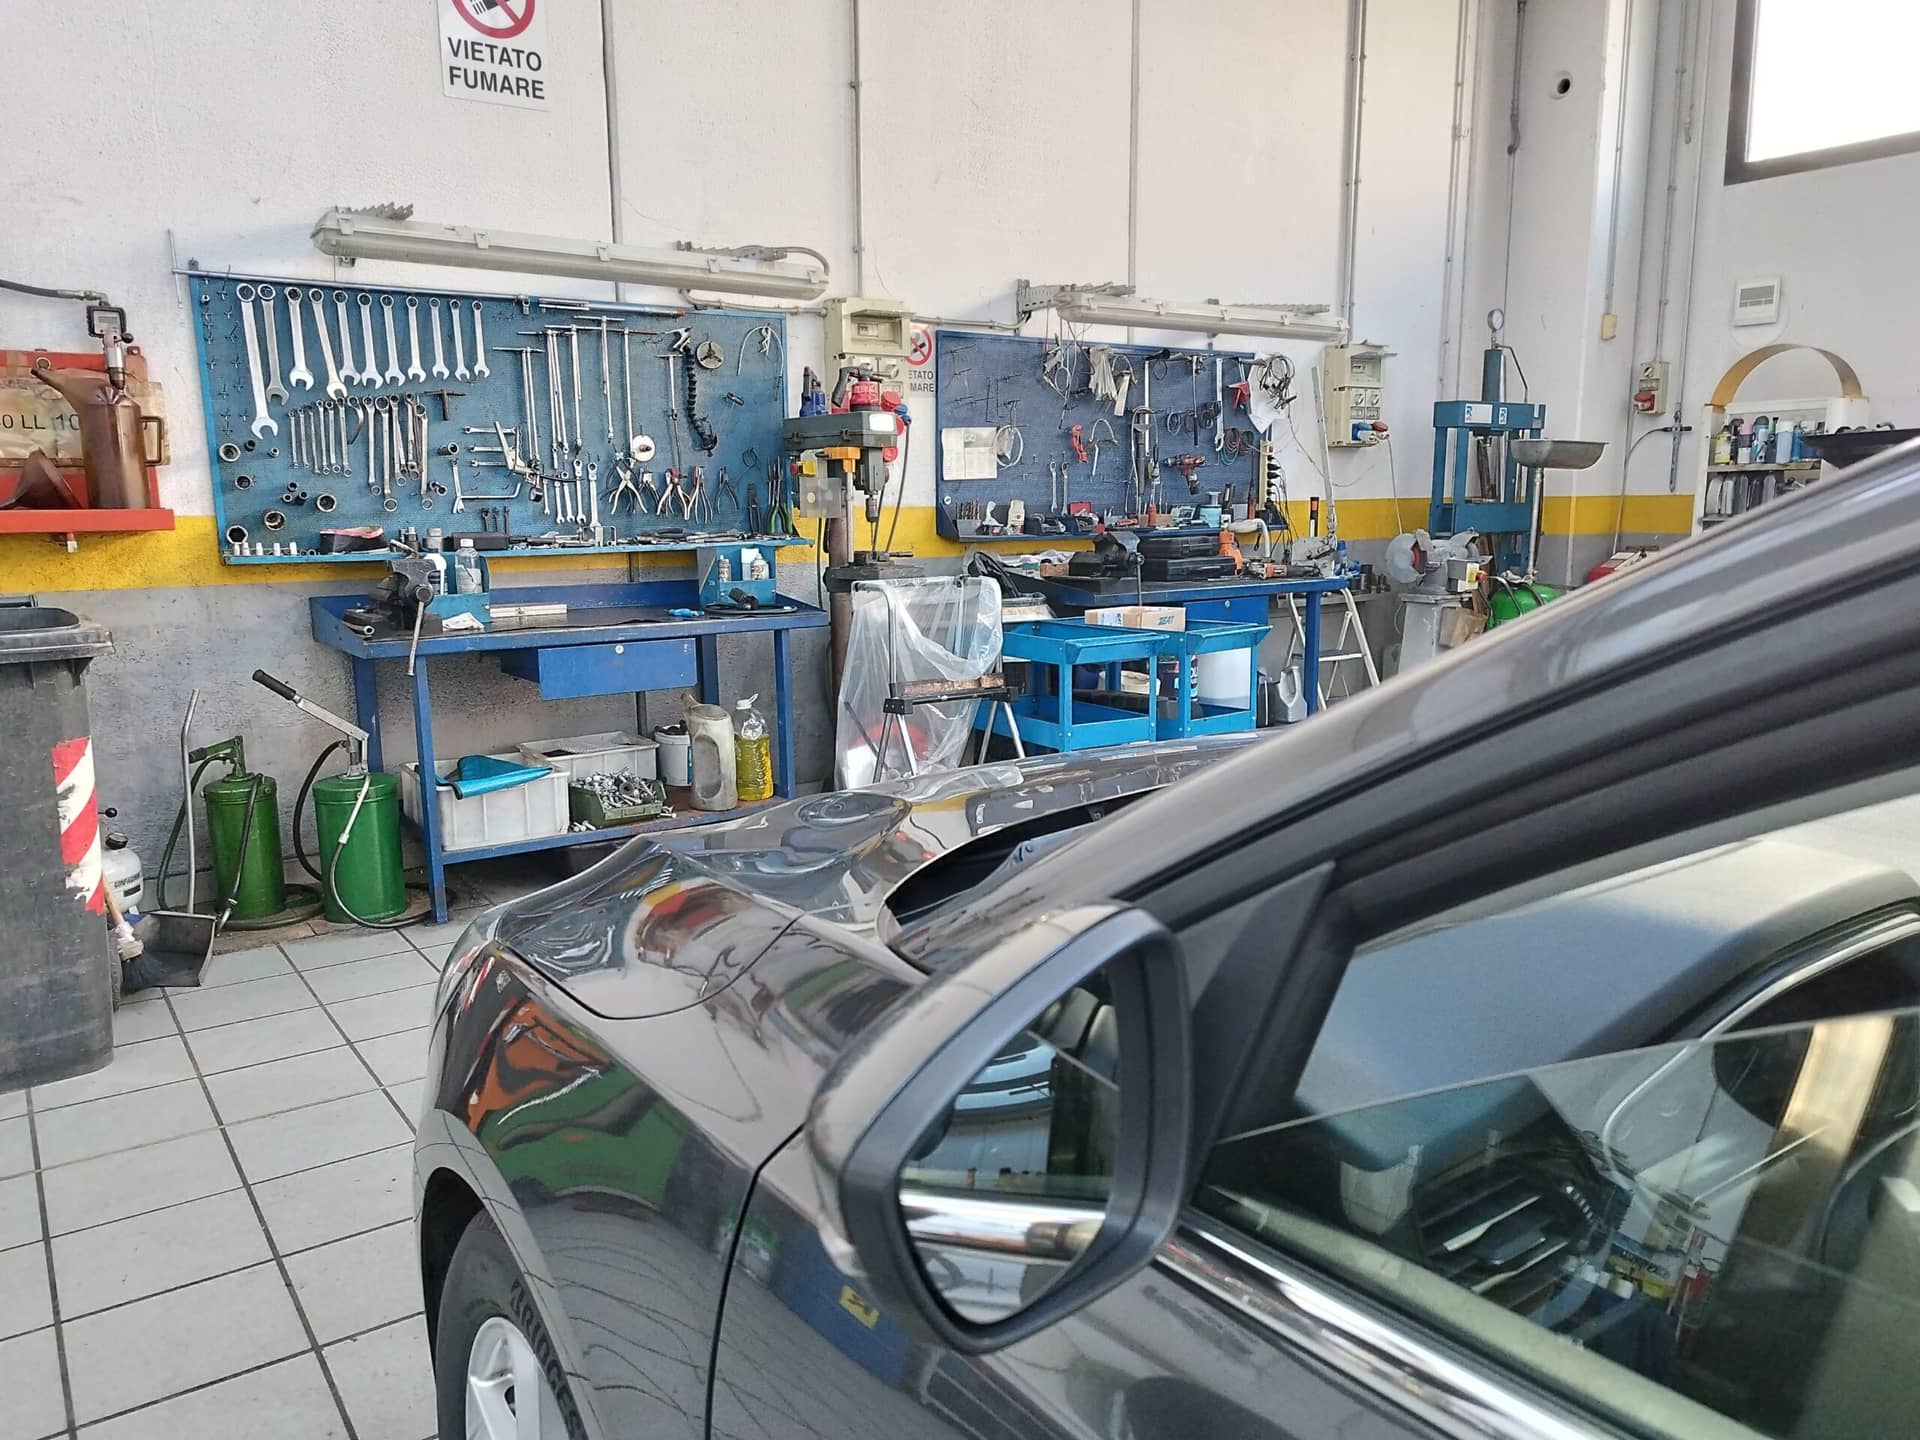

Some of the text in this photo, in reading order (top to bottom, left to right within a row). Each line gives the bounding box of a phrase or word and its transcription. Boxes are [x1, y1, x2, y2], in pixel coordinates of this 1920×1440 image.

[447, 37, 541, 71] VIETATO
[449, 66, 545, 99] FUMARE
[910, 383, 935, 393] MARE
[21, 414, 46, 429] LL
